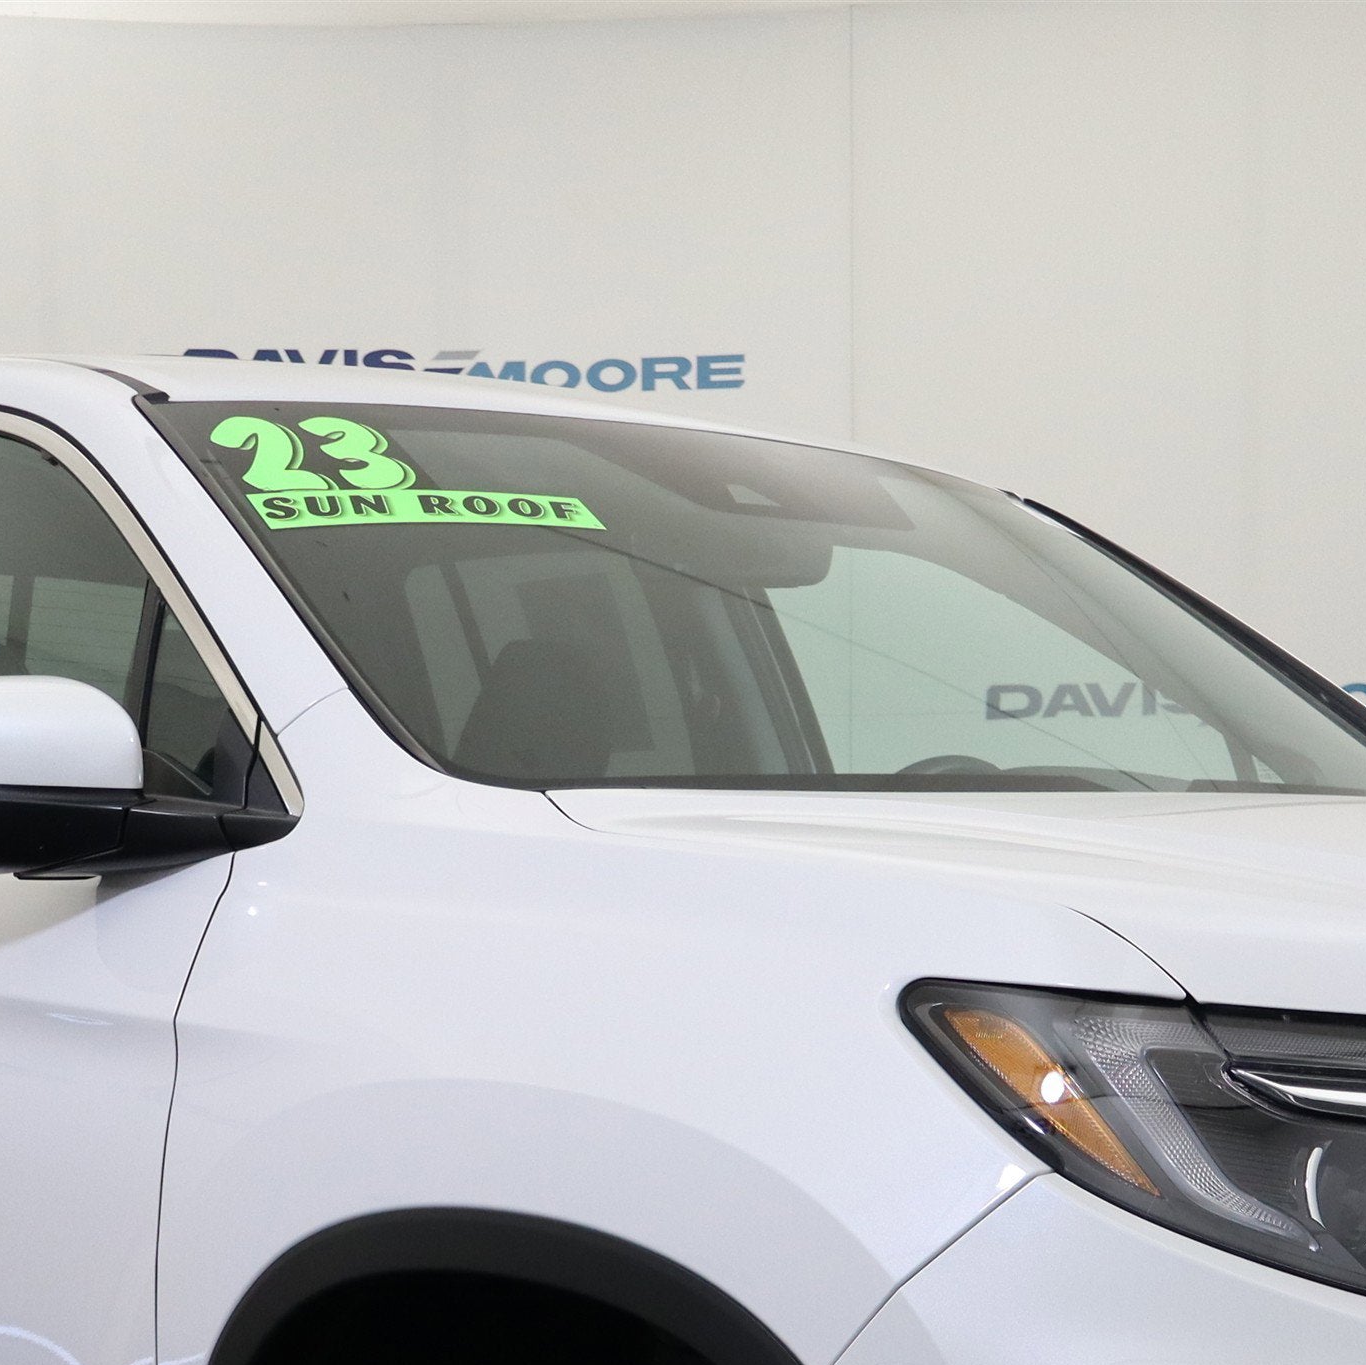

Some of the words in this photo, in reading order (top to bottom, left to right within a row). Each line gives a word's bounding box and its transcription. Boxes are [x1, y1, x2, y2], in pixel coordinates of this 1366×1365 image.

[210, 416, 416, 491] 23
[262, 494, 391, 520] SUN
[419, 494, 581, 521] ROOF
